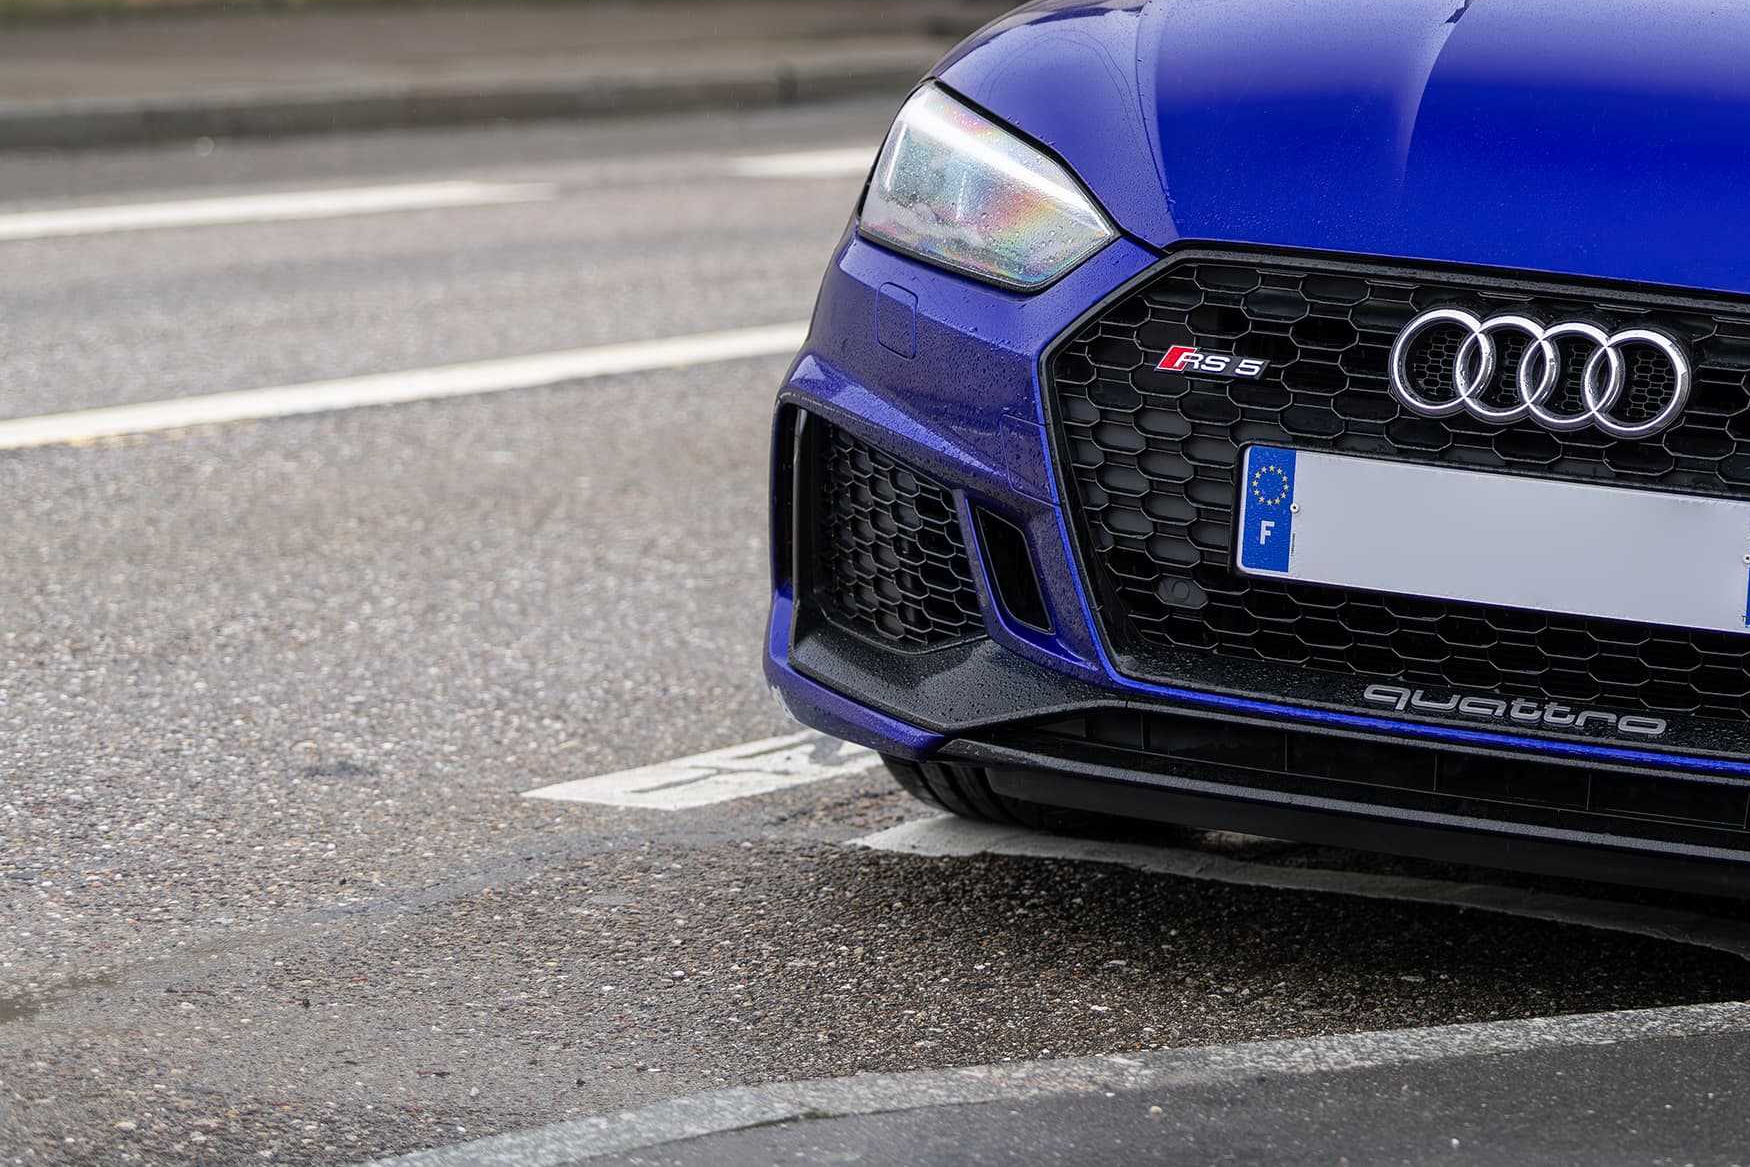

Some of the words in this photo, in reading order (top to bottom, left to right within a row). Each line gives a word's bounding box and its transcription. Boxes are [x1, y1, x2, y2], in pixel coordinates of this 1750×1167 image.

[1174, 351, 1231, 372] RS
[1234, 359, 1265, 376] 5
[1259, 520, 1275, 545] F
[1363, 683, 1668, 735] quattro
